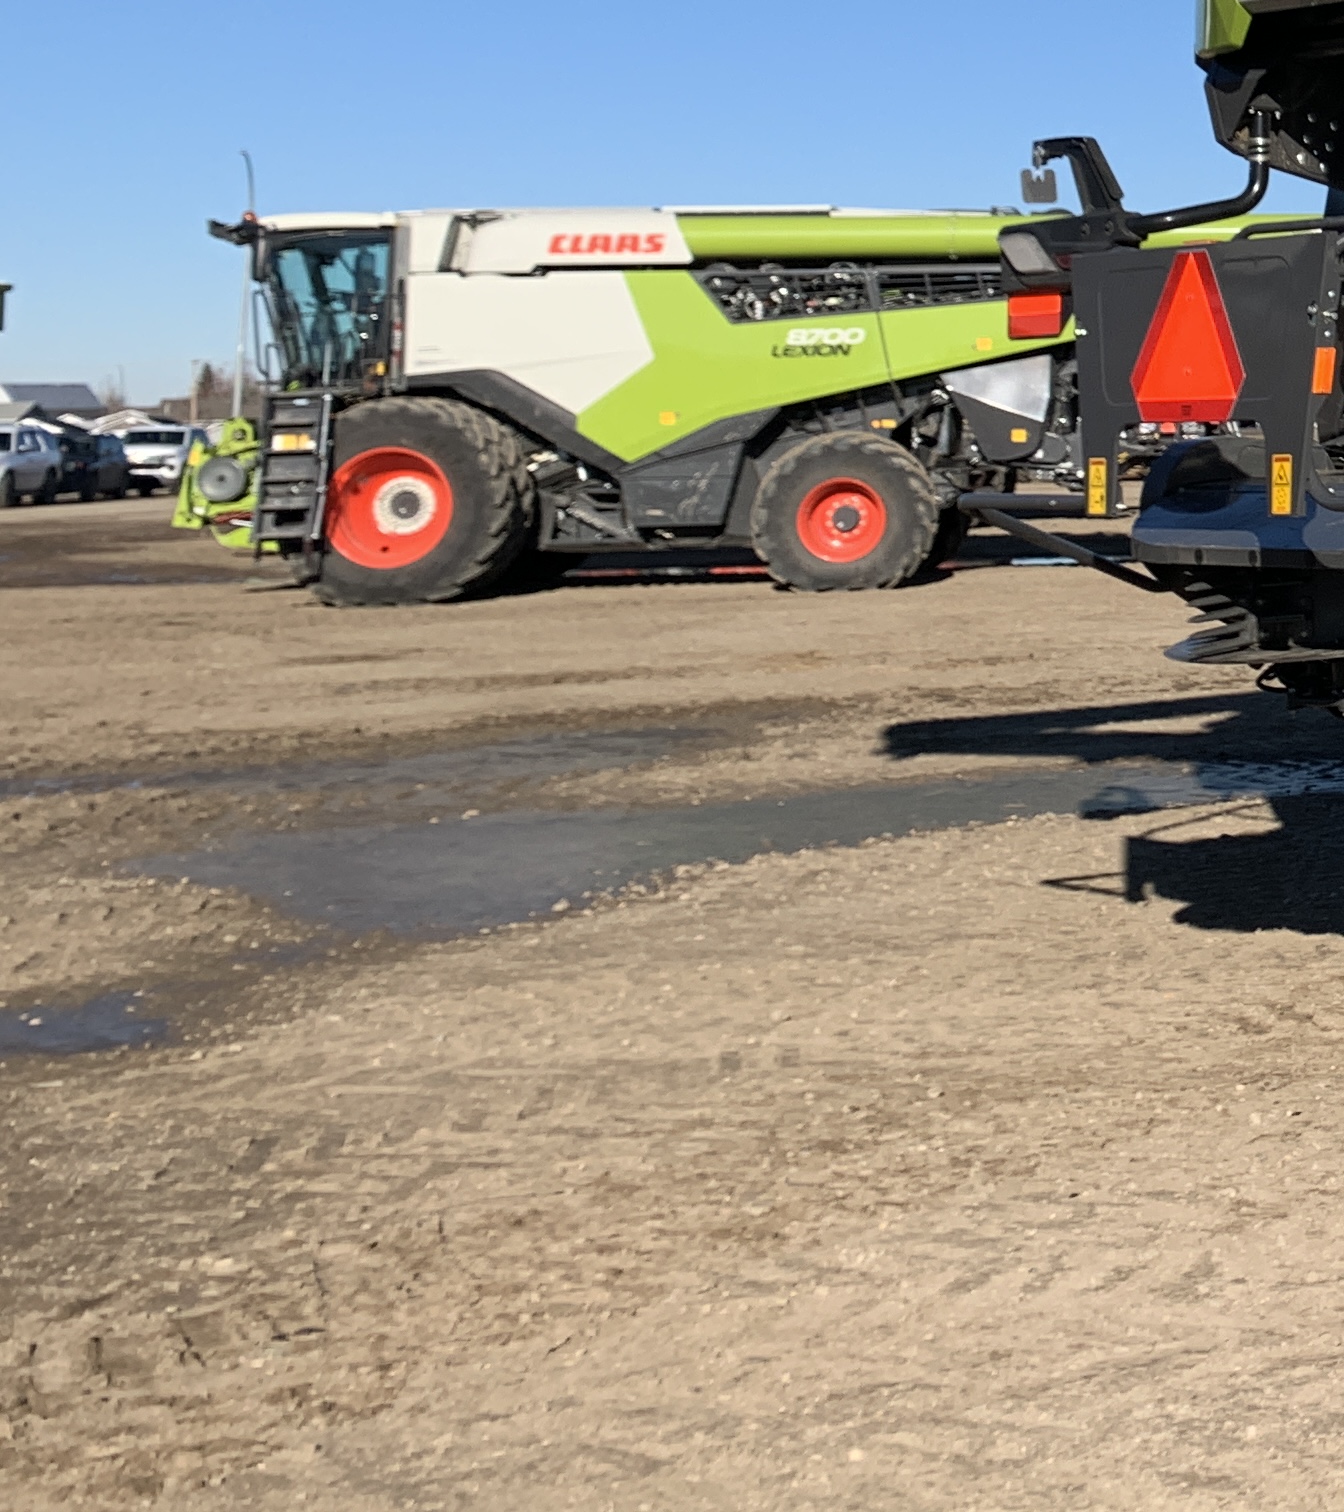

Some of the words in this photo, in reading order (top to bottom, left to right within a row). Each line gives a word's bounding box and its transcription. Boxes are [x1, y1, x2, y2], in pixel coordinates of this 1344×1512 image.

[547, 233, 666, 255] CLAAS
[785, 327, 867, 346] 8700
[771, 343, 852, 358] LEXION
